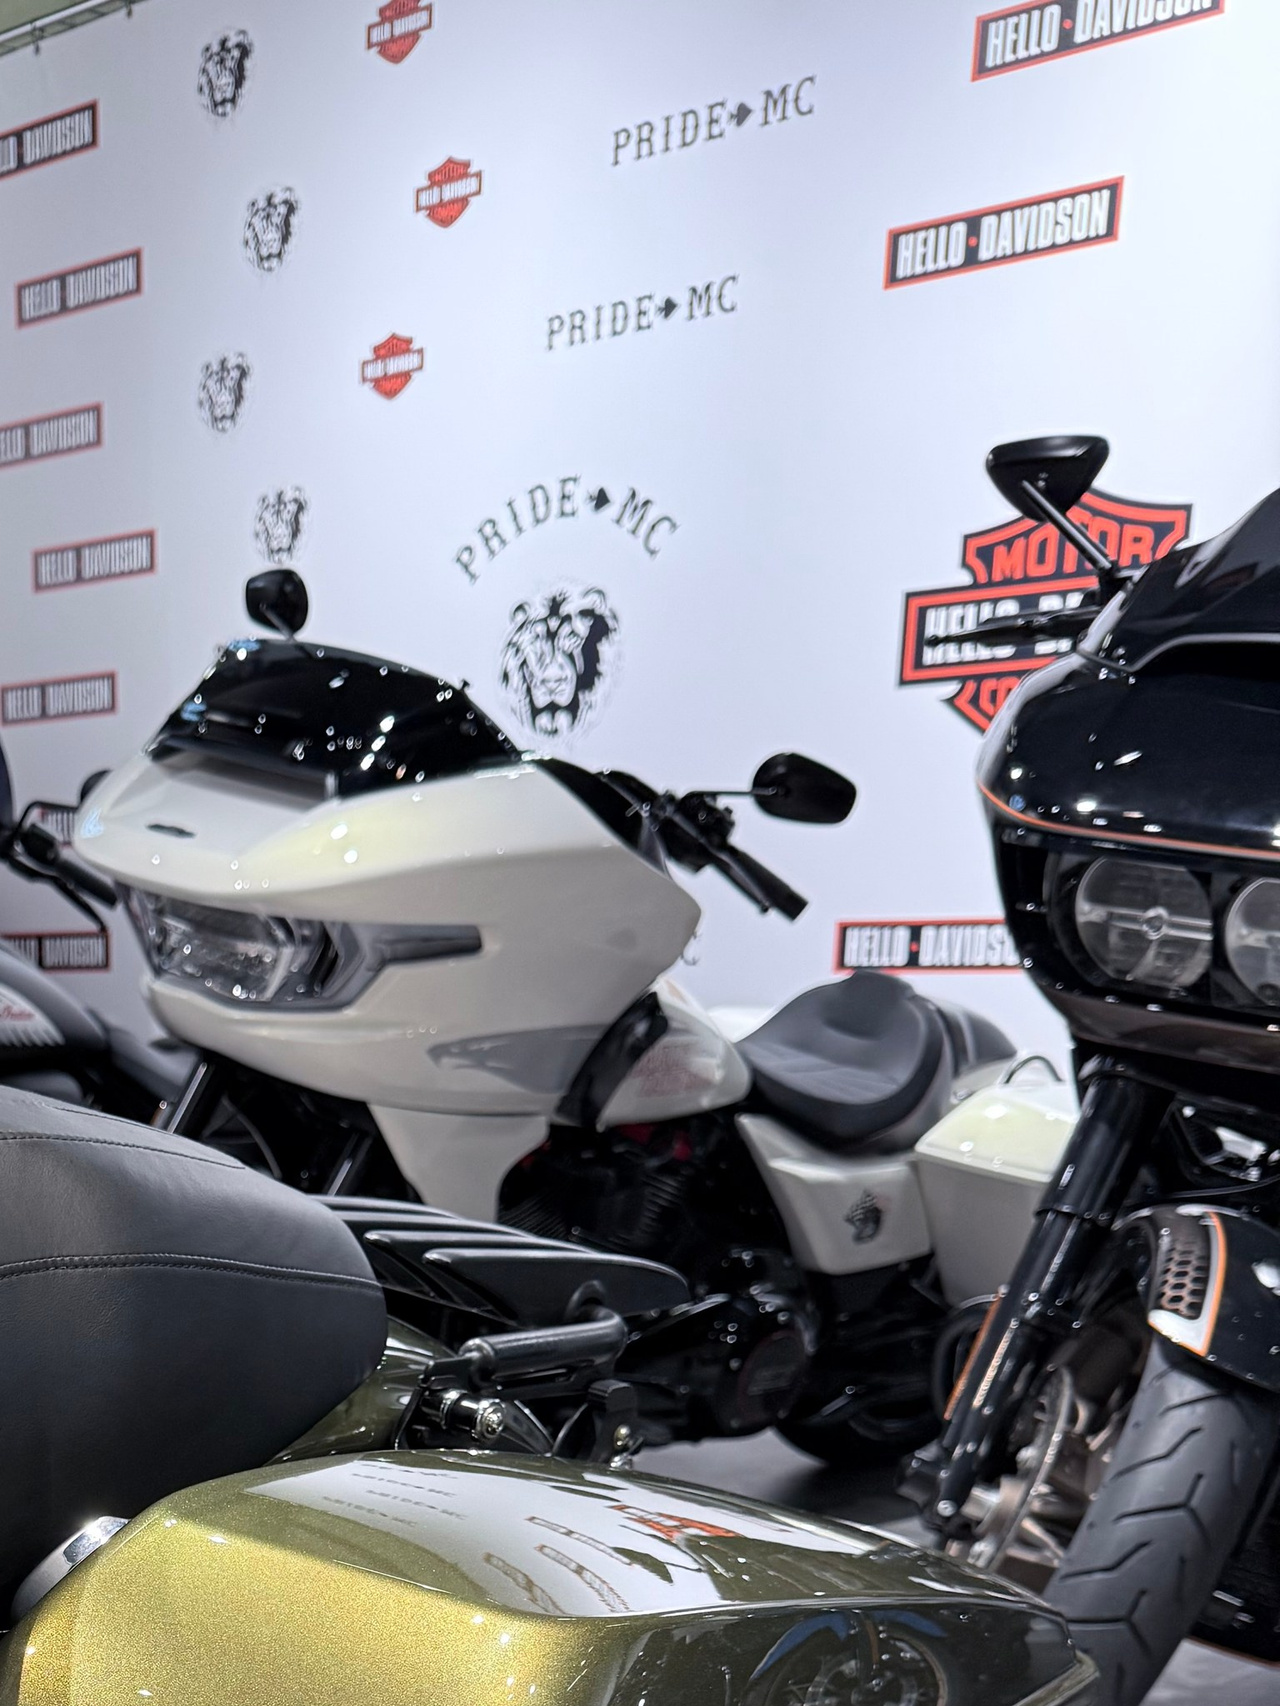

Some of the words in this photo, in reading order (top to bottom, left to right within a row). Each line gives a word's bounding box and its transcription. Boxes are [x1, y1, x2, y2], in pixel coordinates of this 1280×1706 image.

[985, 4, 1062, 68] HELLO
[611, 99, 727, 167] PRIDE
[759, 75, 817, 127] MC
[895, 220, 968, 280] HELLO
[977, 188, 1111, 262] DAVIDSON
[545, 292, 656, 351] PRIDE
[686, 274, 739, 321] MC
[453, 474, 581, 585] PRIDE
[611, 486, 681, 560] MC
[843, 925, 911, 968] HELLO
